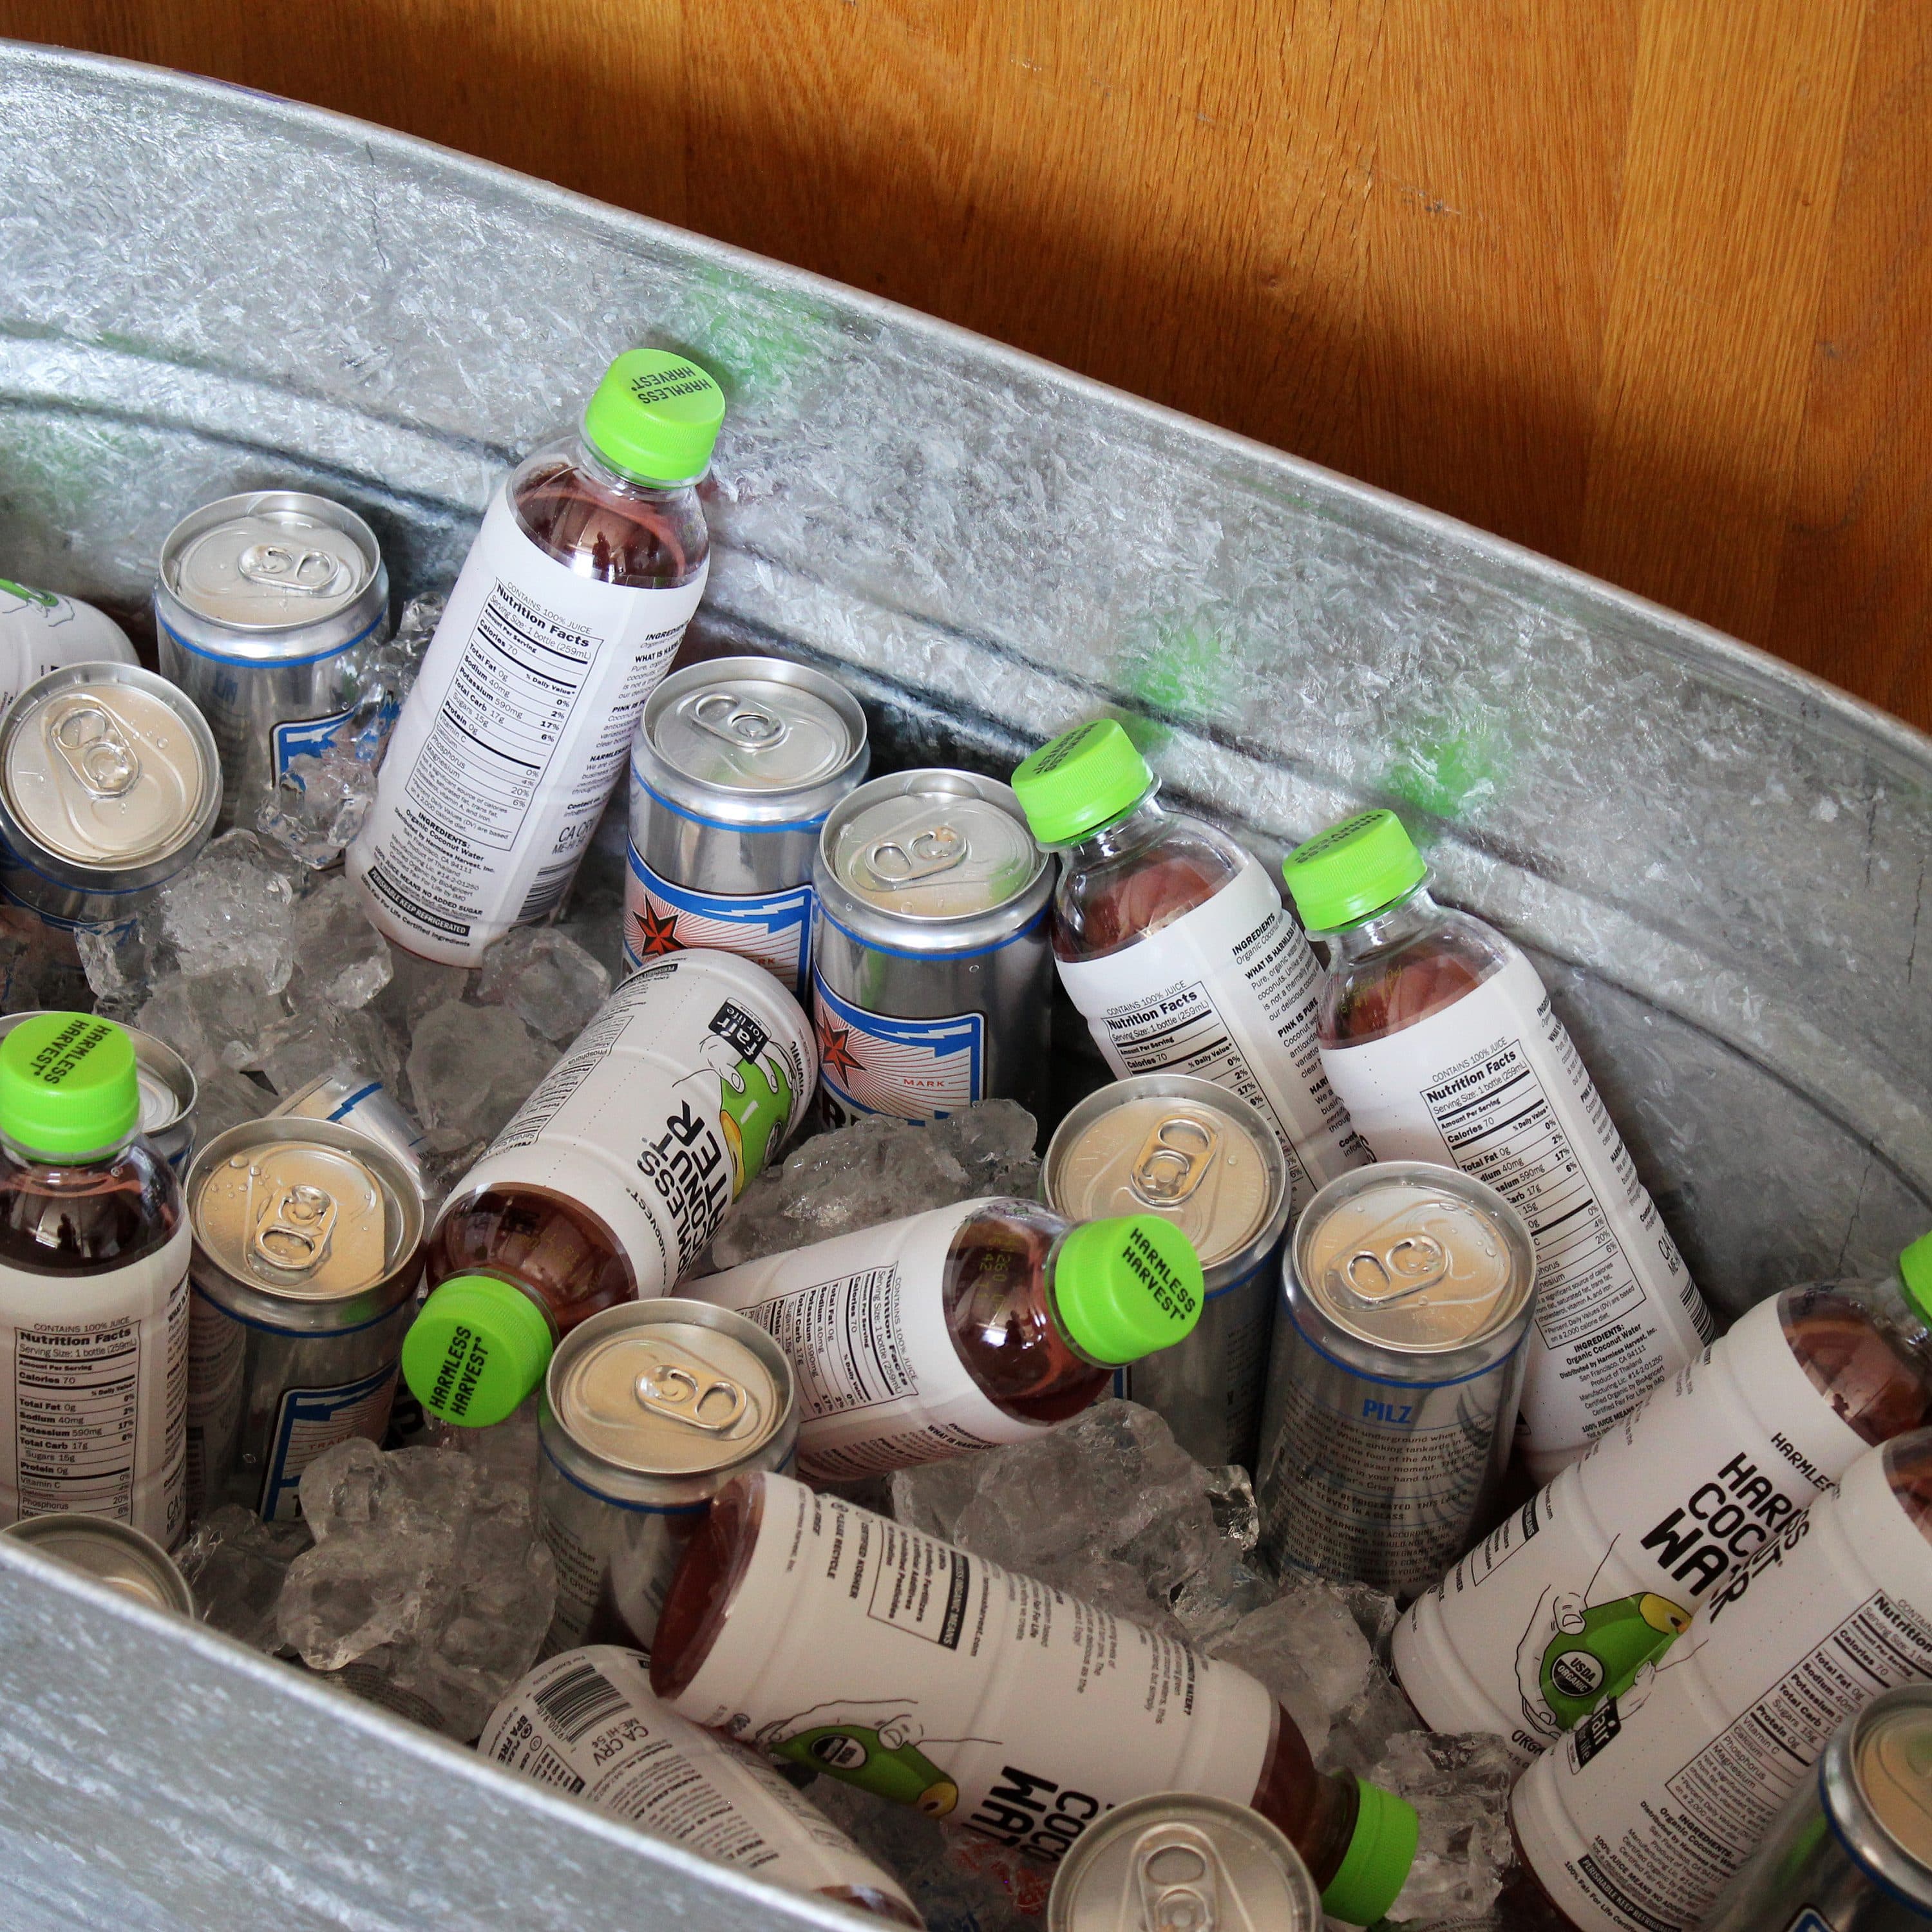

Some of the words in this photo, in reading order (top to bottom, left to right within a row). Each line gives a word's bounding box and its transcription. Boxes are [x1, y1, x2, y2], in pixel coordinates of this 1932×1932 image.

[638, 379, 712, 404] HARMLESS
[489, 594, 511, 619] Serving
[510, 614, 526, 630] Size:
[533, 630, 555, 647] bottle
[556, 642, 591, 660] (259mL)
[497, 583, 545, 629] Nutrition
[549, 625, 589, 647] Facts
[507, 582, 541, 611] CONTAINS
[542, 609, 565, 624] 100%
[567, 621, 592, 634] JUICE
[480, 619, 505, 647] Calories
[508, 645, 517, 654] 70
[484, 608, 502, 628] Amount
[502, 626, 512, 636] Per
[513, 634, 536, 653] Serving
[469, 643, 484, 661] Total
[484, 659, 496, 672] Fat
[498, 670, 507, 681] 0g
[455, 677, 469, 696] Total
[469, 694, 486, 711] Carb
[491, 710, 504, 724] 17g
[459, 666, 493, 701] Potassium
[495, 698, 522, 719] 590mg
[540, 721, 559, 730] 17%
[464, 654, 487, 681] Sodium
[489, 679, 509, 697] 40mg
[551, 710, 564, 719] 2%
[532, 677, 549, 688] Daily
[445, 700, 466, 725] Protein
[469, 724, 477, 735] 0g
[453, 692, 472, 715] Sugars
[474, 713, 489, 728] 15g
[426, 743, 460, 779] Magnesium
[440, 712, 459, 737] Vitamin
[526, 769, 538, 777] 0%
[430, 734, 465, 769] Phosphorus
[511, 786, 529, 797] 20%
[406, 809, 428, 832] Organic
[429, 829, 459, 851] Coconut
[461, 848, 484, 861] Water
[418, 811, 469, 848] INGREDIENTS:
[1232, 913, 1274, 955] INGREDIENTS
[1244, 960, 1265, 979] WHAT
[1265, 954, 1273, 963] IS
[1271, 927, 1294, 957] HARMLESS
[1106, 1001, 1141, 1016] CONTAINS
[1141, 992, 1164, 1005] 100%
[1164, 980, 1186, 996] JUICE
[1106, 1010, 1159, 1030] Nutrition
[1159, 992, 1197, 1014] Facts
[1277, 1019, 1297, 1037] PINK
[1295, 1012, 1303, 1023] IS
[1302, 996, 1318, 1016] PURE
[1112, 1032, 1135, 1044] Serving
[1133, 1028, 1150, 1037] Size:
[1155, 1017, 1177, 1030] bottle
[1177, 1000, 1209, 1021] (259mL)
[44, 1025, 113, 1084] HARMLESS
[1126, 1057, 1156, 1068] Calories
[1155, 1053, 1167, 1061] 70
[1432, 1059, 1470, 1082] CONTAINS
[1470, 1048, 1490, 1064] 100%
[1490, 1036, 1507, 1053] JUICE
[904, 1078, 945, 1087] MARK
[1426, 1070, 1484, 1103] Nutrition
[1485, 1051, 1515, 1074] Facts
[1432, 1097, 1462, 1114] Serving
[1460, 1090, 1478, 1102] Size:
[1482, 1077, 1502, 1090] bottle
[1501, 1061, 1527, 1081] (259mL)
[1447, 1124, 1482, 1143] Calories
[1484, 1117, 1493, 1126] 70
[1461, 1158, 1484, 1172] Total
[1483, 1151, 1498, 1163] Fat
[1499, 1147, 1510, 1155] 0g
[1544, 1119, 1556, 1130] 0%
[1502, 1157, 1524, 1171] 40mg
[1551, 1133, 1562, 1144] 2%
[1519, 1164, 1545, 1181] 590mg
[1555, 1148, 1569, 1160] 17%
[1526, 1184, 1541, 1195] 17g
[1566, 1161, 1577, 1172] 6%
[1130, 1227, 1195, 1312] HARMLESS
[851, 1276, 860, 1317] Calories
[884, 1268, 895, 1339] Nutrition
[20, 1331, 90, 1345] Nutrition
[95, 1328, 130, 1343] Facts
[33, 1323, 80, 1332] CONTAINS
[84, 1322, 107, 1332] 100%
[109, 1316, 129, 1328] JUICE
[851, 1320, 857, 1332] 70
[1573, 1324, 1624, 1352] INGREDIENTS:
[895, 1328, 906, 1355] 100%
[903, 1358, 918, 1381] JUICE
[1559, 1363, 1589, 1379] Distributed
[1596, 1347, 1624, 1364] Harmless
[1624, 1334, 1647, 1350] Harvest,
[1646, 1327, 1657, 1336] Inc.
[1566, 1350, 1592, 1365] Organic
[1593, 1335, 1622, 1354] Coconut
[1620, 1323, 1641, 1339] Water
[19, 1371, 59, 1383] Calories
[430, 1326, 471, 1409] HARMLESS
[889, 1344, 907, 1385] Facts
[19, 1397, 43, 1408] Total
[64, 1403, 75, 1412] 0g
[19, 1411, 55, 1423] Sodium
[1362, 1399, 1412, 1424] PILZ
[848, 1558, 866, 1600] KOSHER
[1570, 1657, 1596, 1682] USDA
[1815, 1651, 1837, 1675] Total
[1835, 1673, 1852, 1689] Fat
[1839, 1629, 1874, 1665] Calories
[1875, 1664, 1888, 1676] 70
[1557, 1665, 1588, 1692] ORGANIC
[593, 1738, 624, 1766] CRV
[623, 1725, 649, 1742] CA
